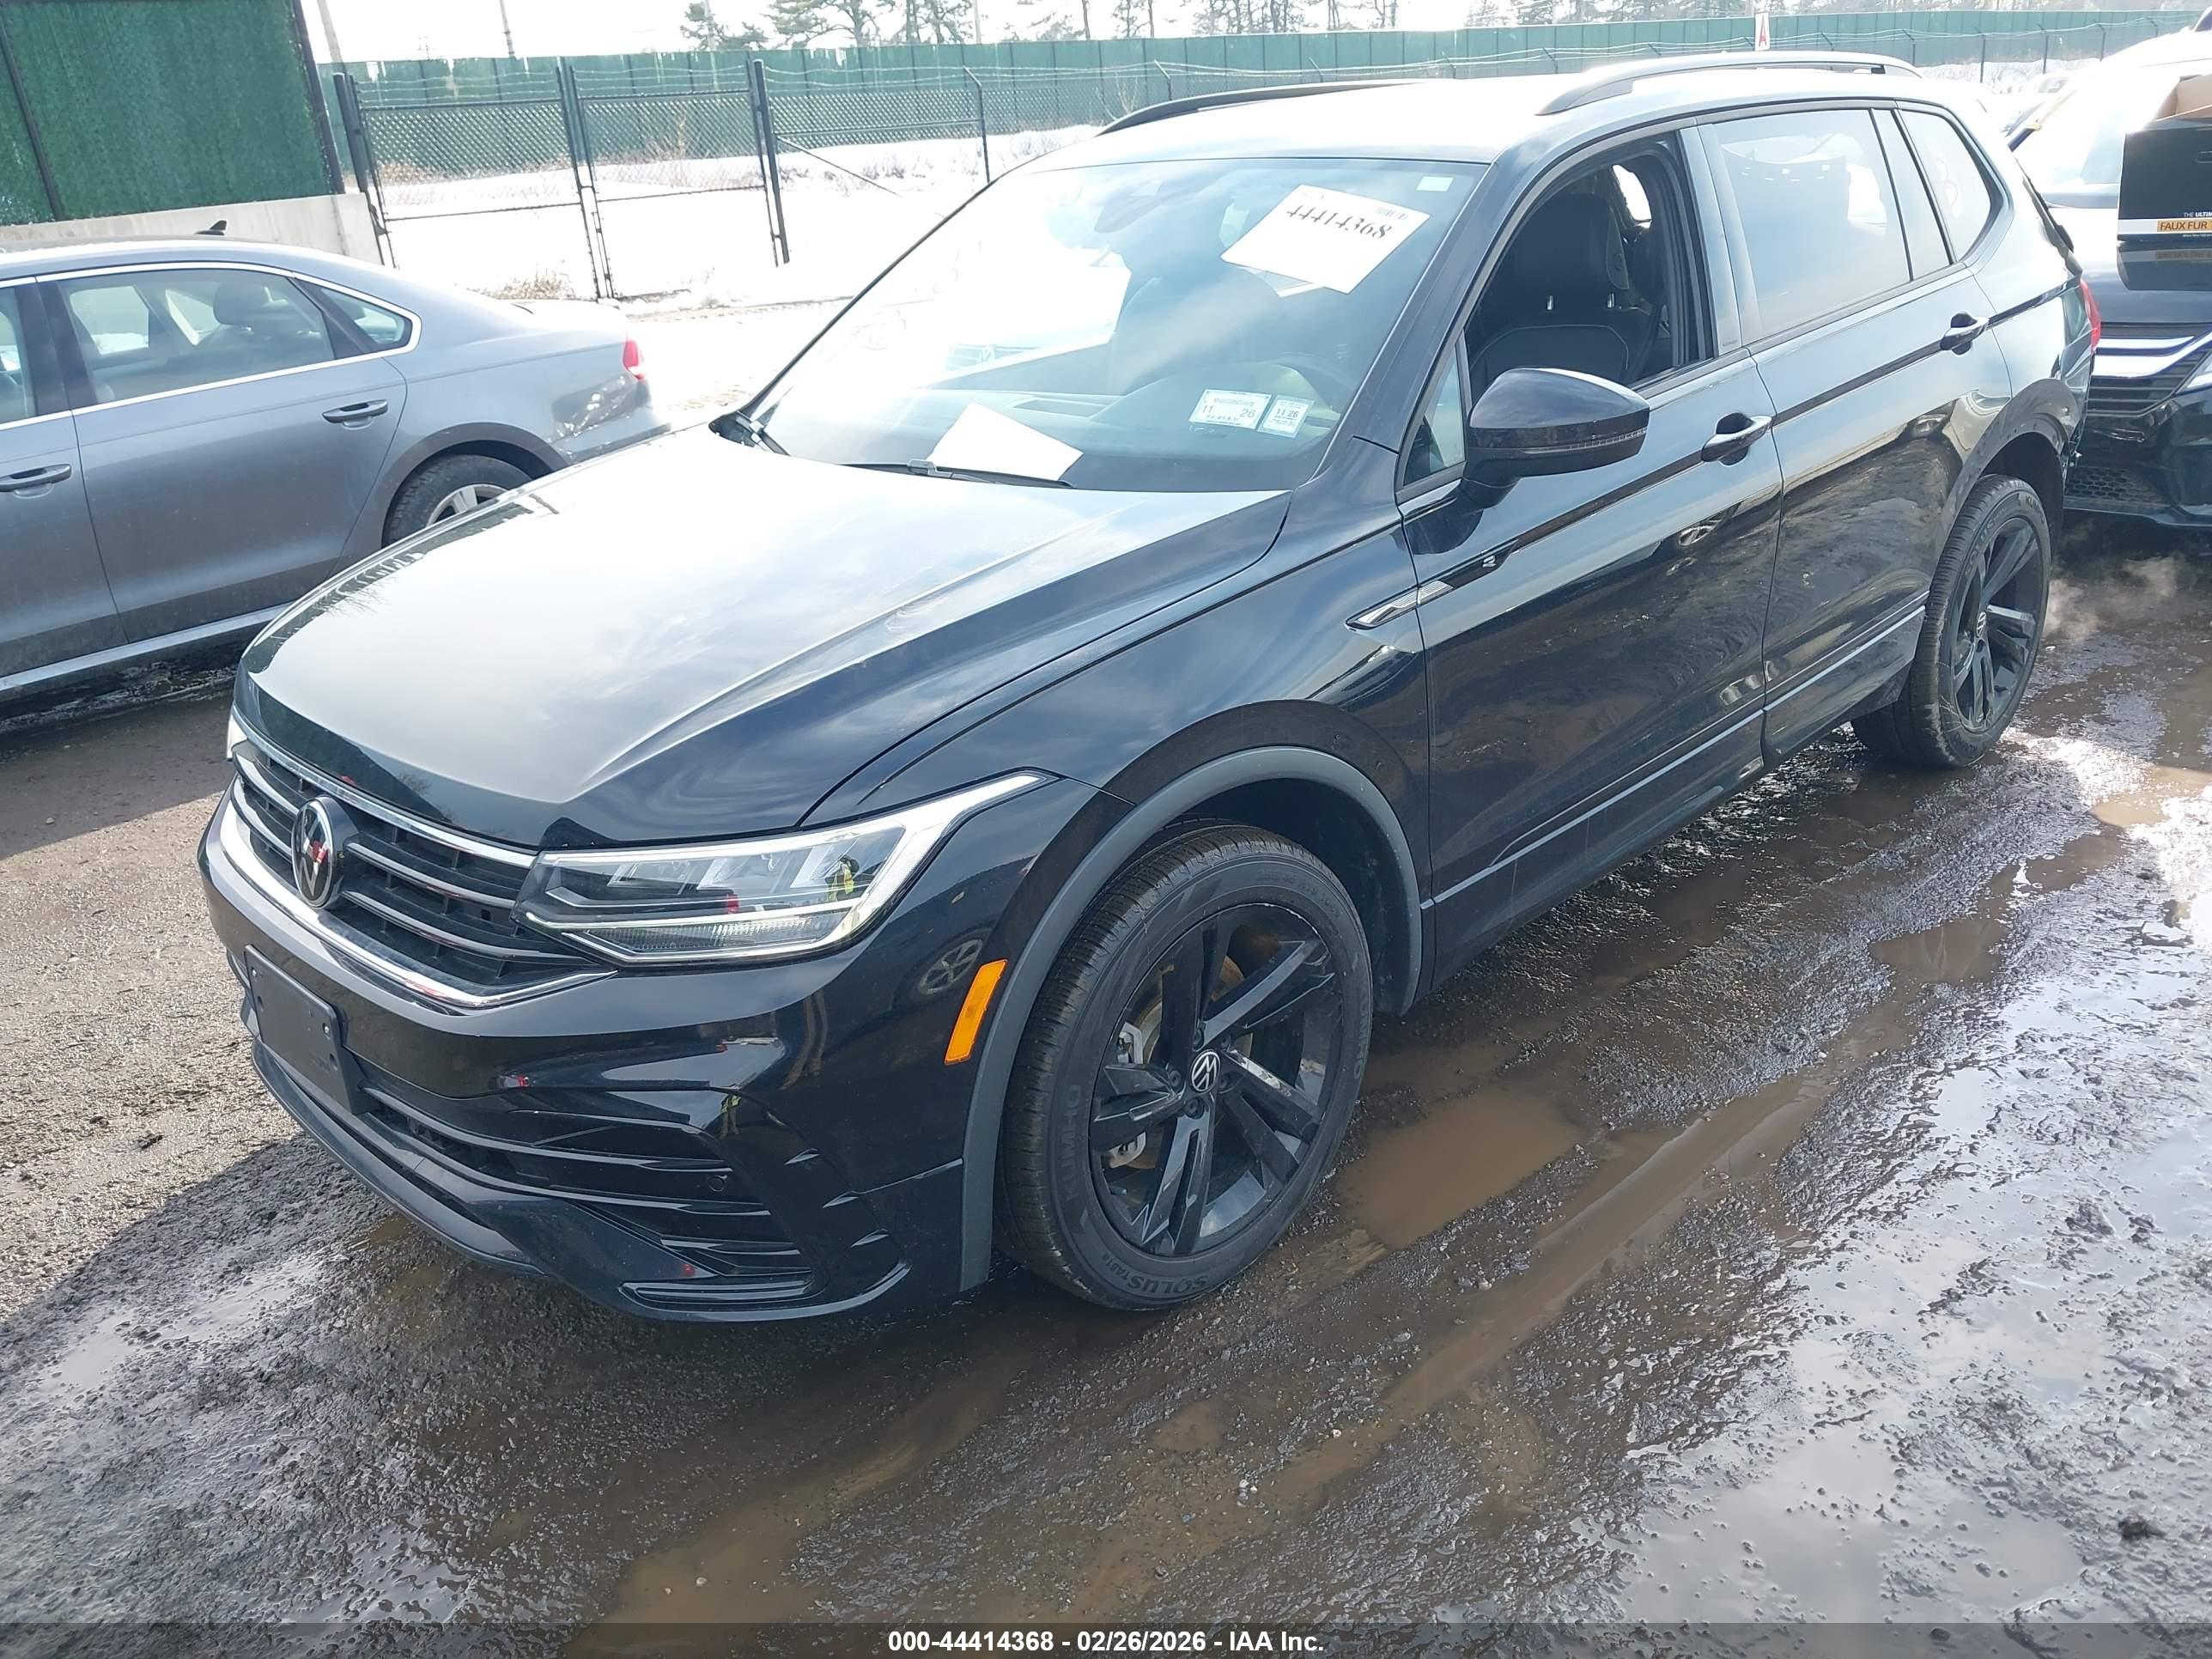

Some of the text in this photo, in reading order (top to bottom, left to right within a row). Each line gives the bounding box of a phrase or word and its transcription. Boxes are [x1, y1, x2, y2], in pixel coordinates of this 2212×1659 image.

[1286, 204, 1393, 240] 44414368
[2160, 220, 2208, 230] FAUX FUR
[1239, 408, 1256, 419] 26
[1127, 1274, 1208, 1294] SOLUS
